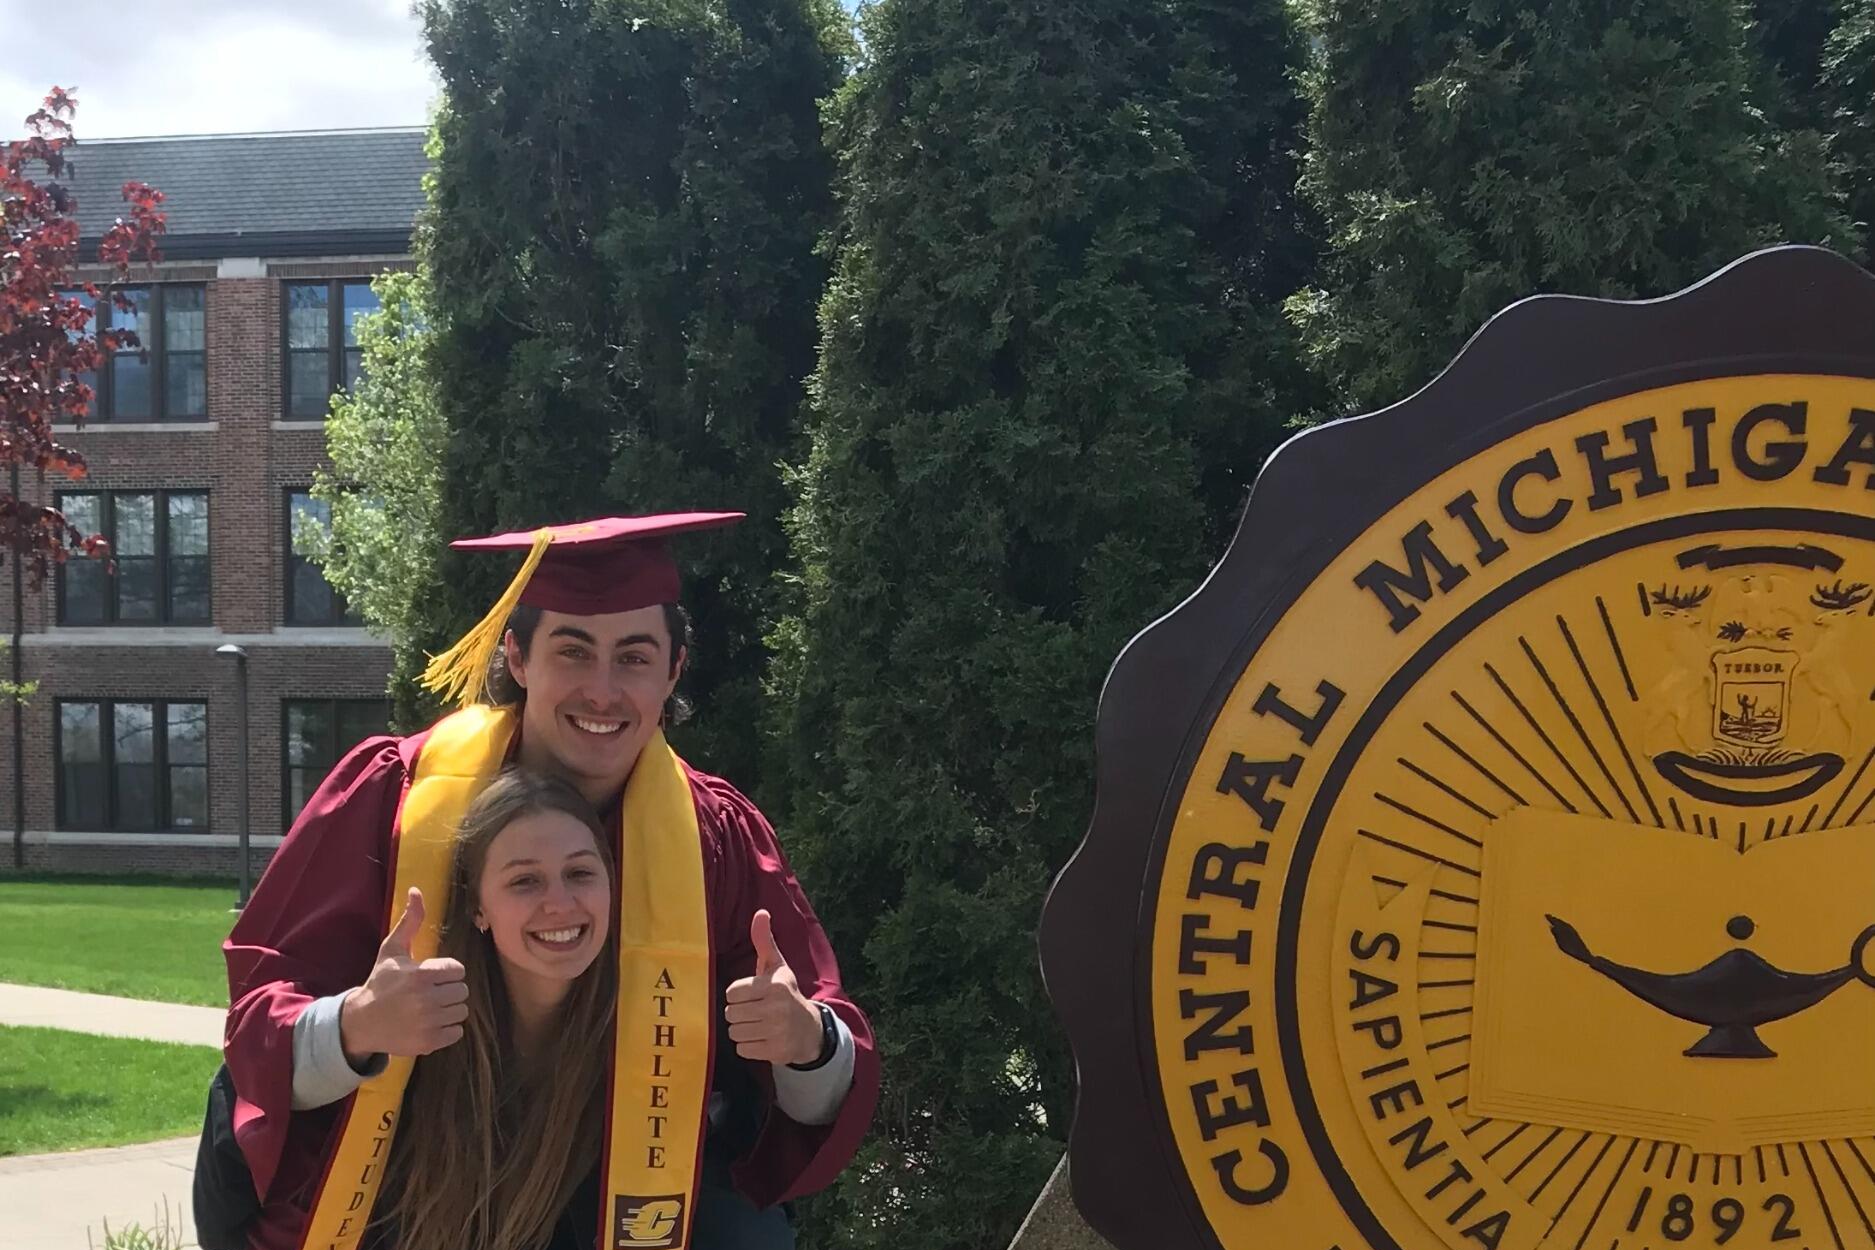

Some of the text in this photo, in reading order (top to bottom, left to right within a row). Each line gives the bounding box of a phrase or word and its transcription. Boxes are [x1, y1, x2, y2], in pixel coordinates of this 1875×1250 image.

[1178, 401, 1875, 1206] CENTRAL MICHIGA
[645, 967, 676, 1169] ATHLETE
[1625, 1186, 1801, 1246] 1892
